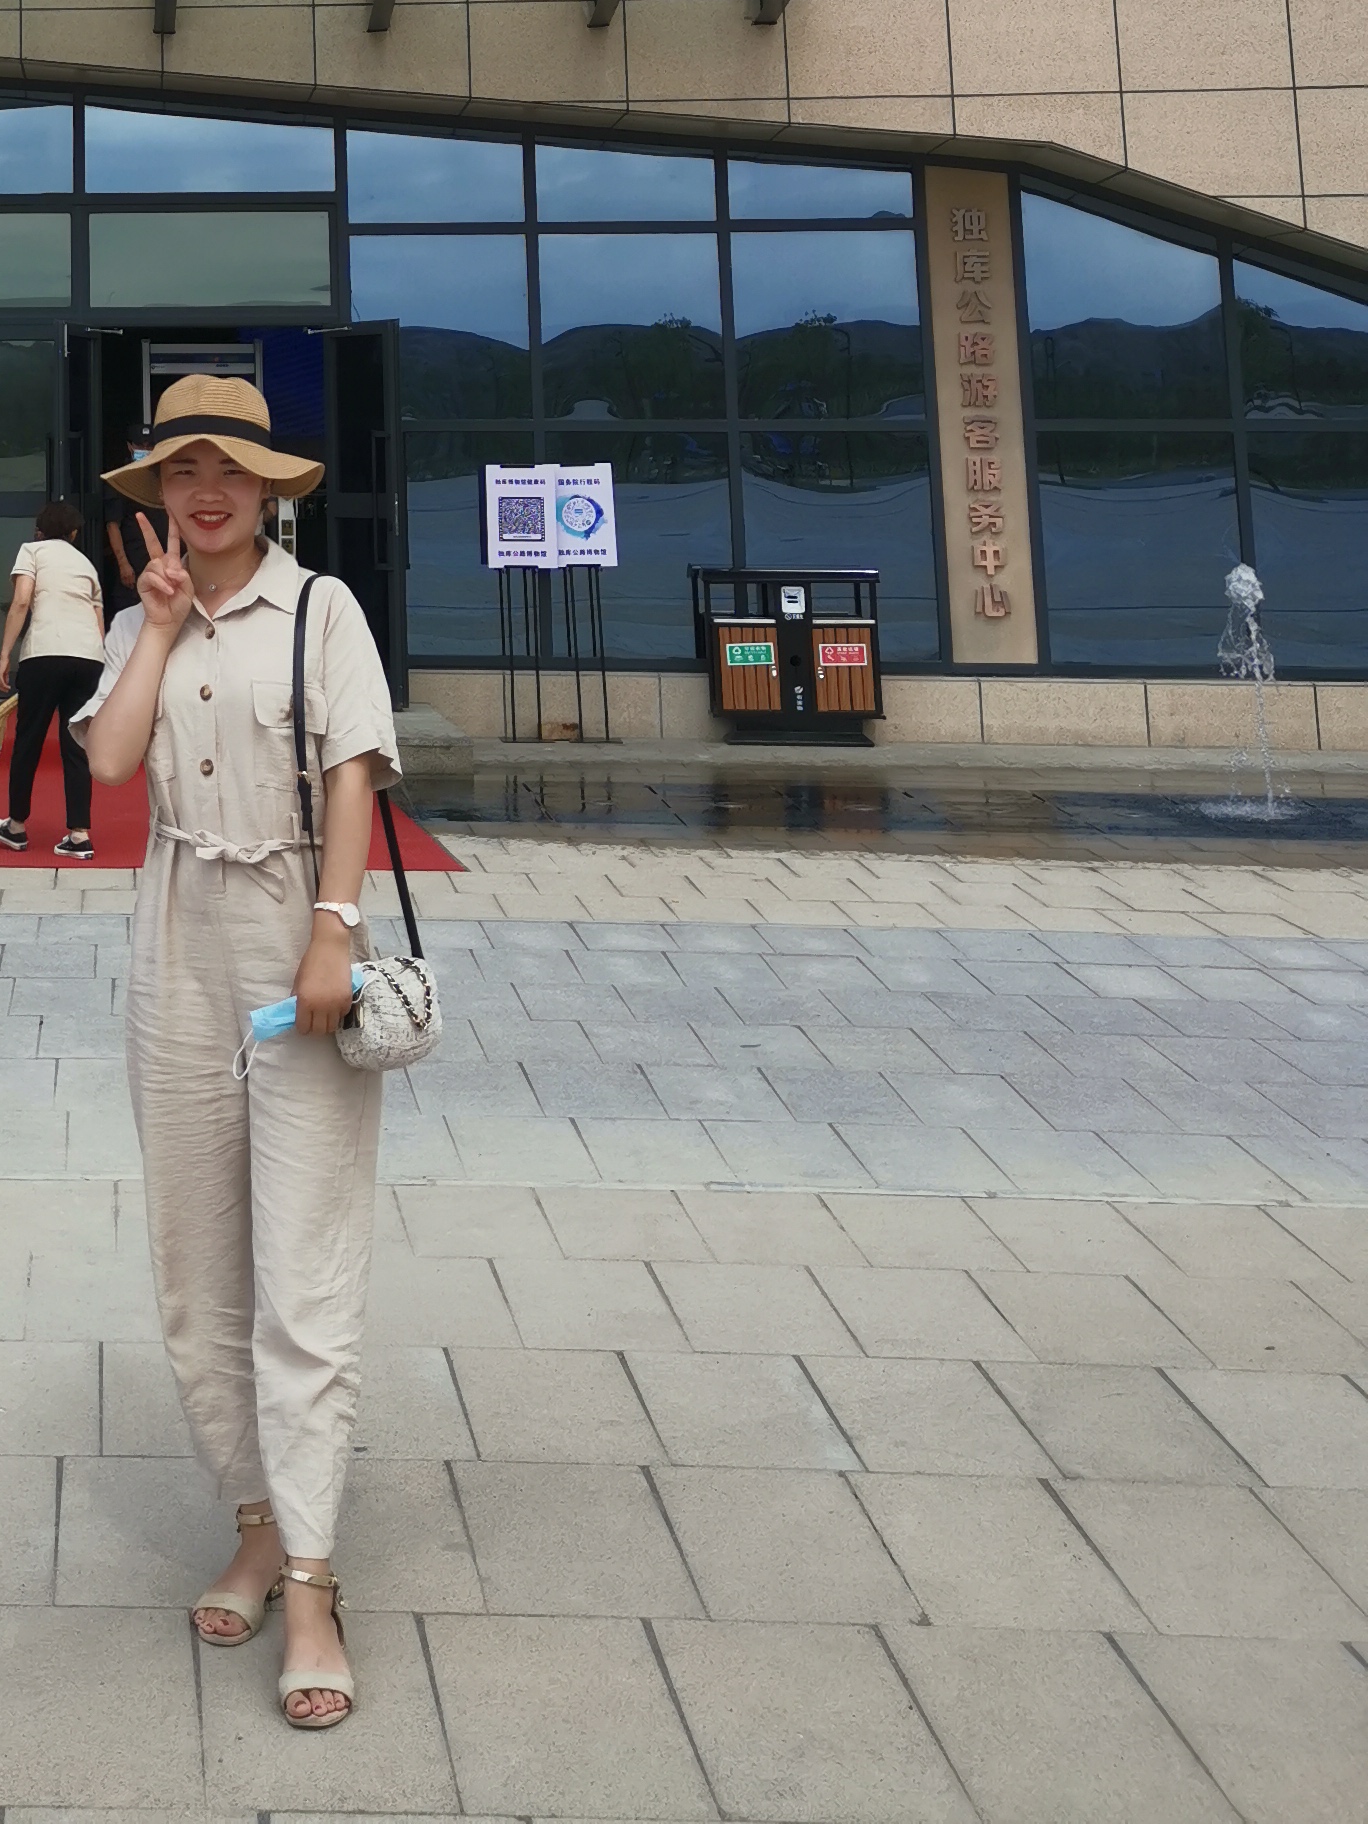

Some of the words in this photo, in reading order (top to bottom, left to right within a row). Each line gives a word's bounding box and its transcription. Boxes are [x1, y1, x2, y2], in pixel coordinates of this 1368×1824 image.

[950, 208, 1012, 618] 独库公路游客服务中心
